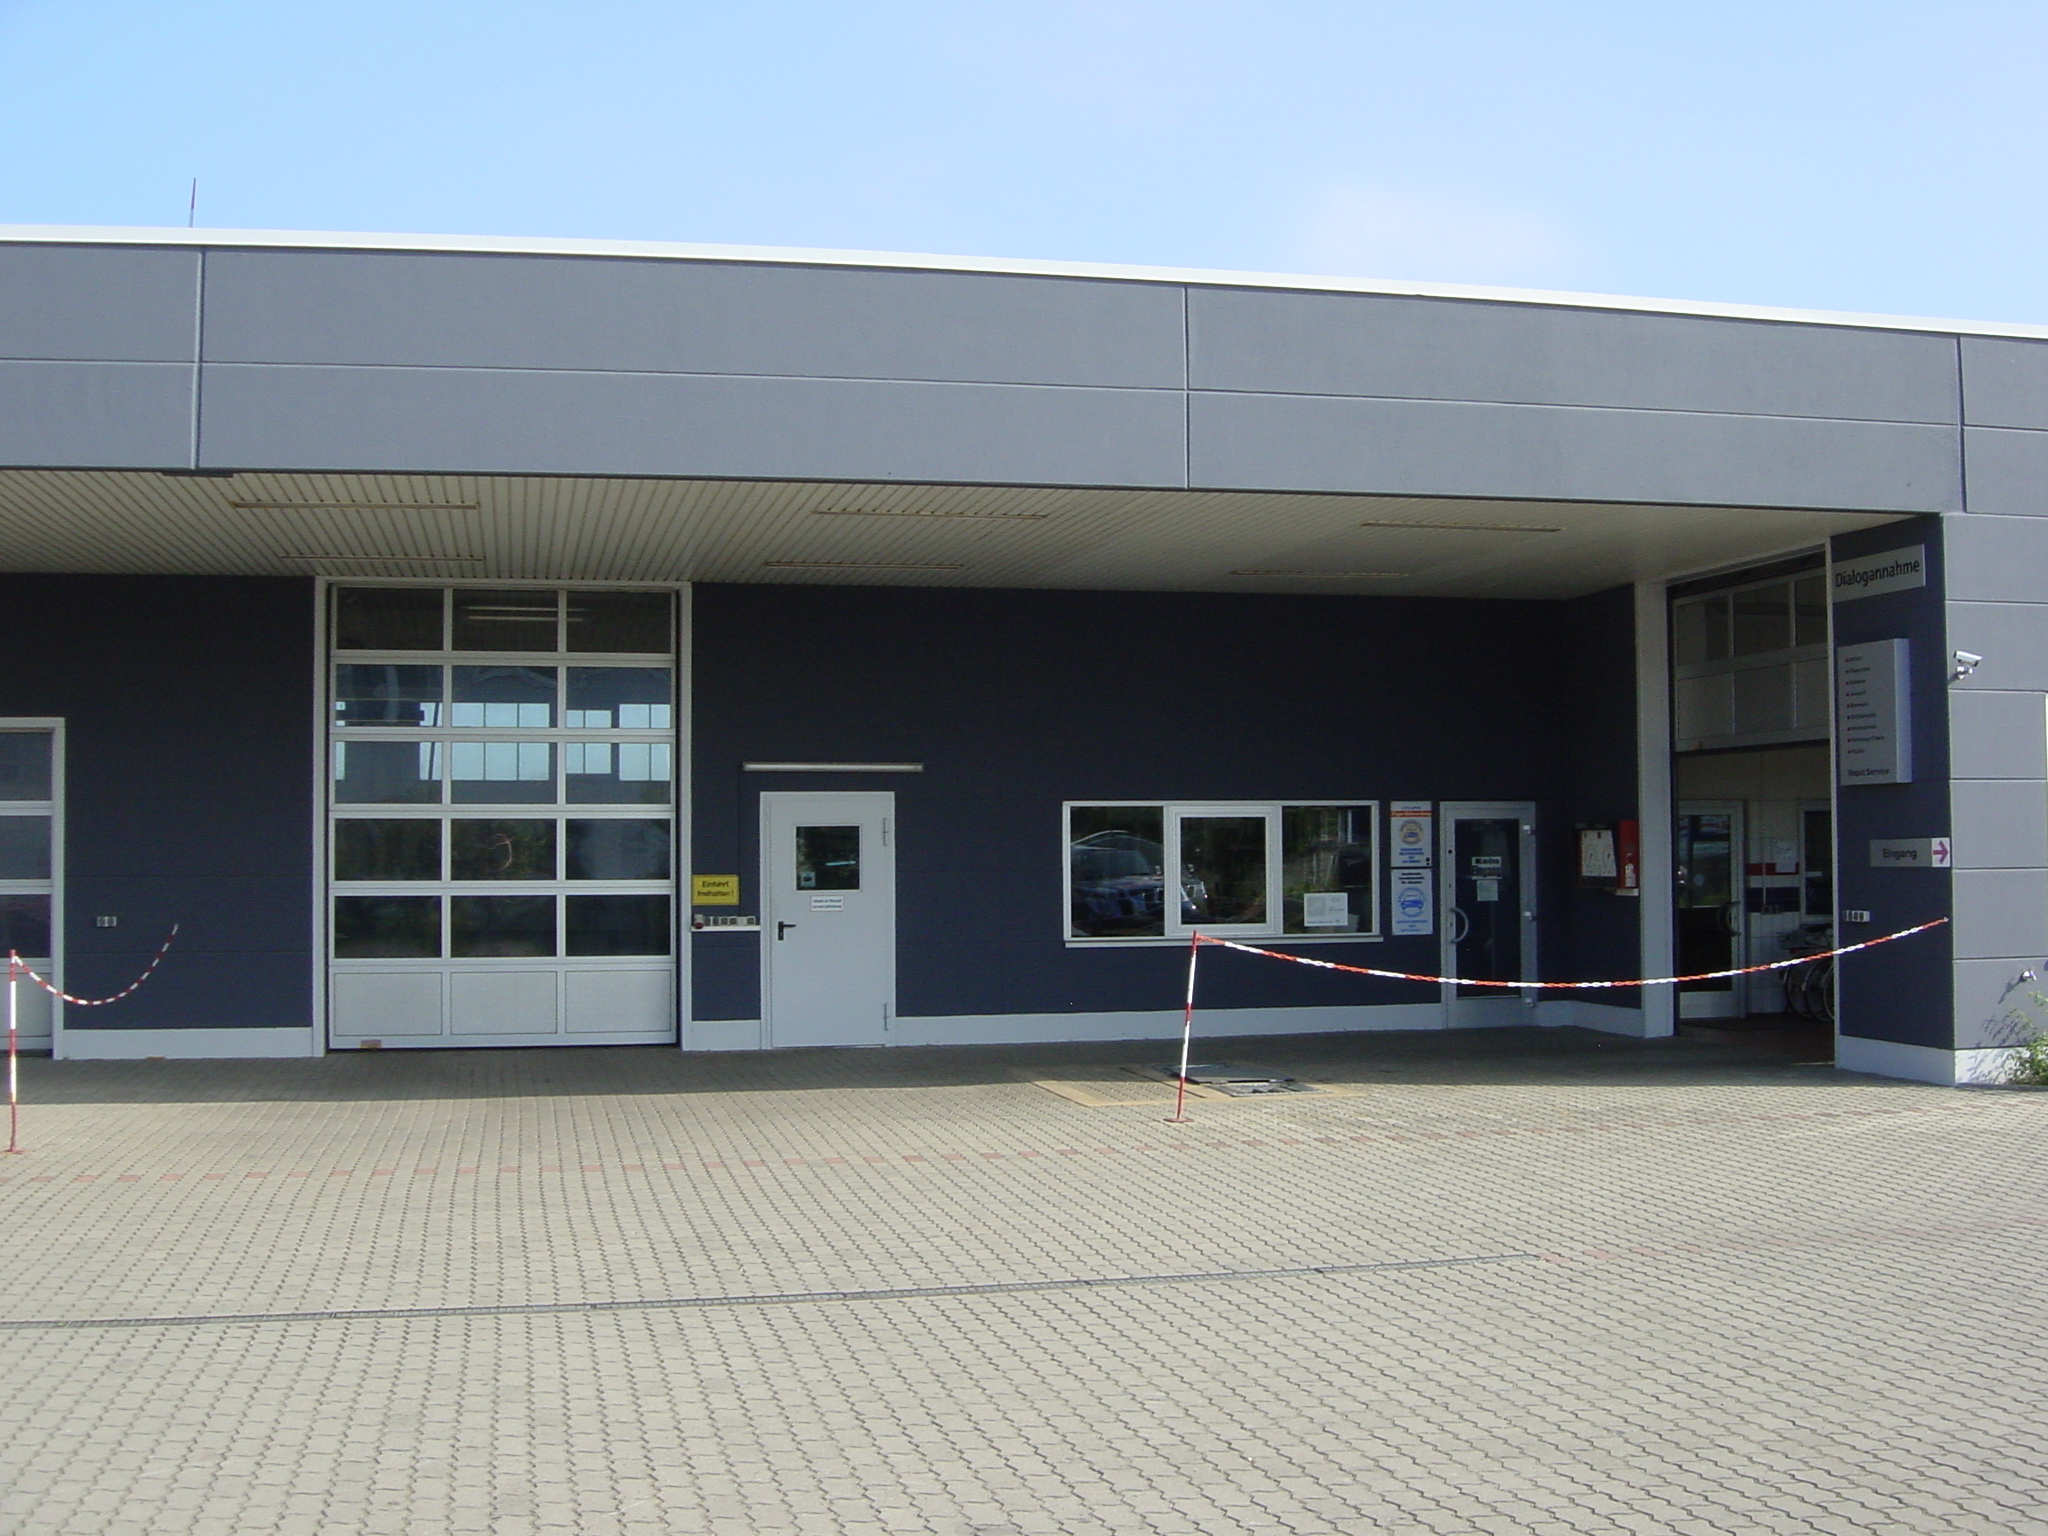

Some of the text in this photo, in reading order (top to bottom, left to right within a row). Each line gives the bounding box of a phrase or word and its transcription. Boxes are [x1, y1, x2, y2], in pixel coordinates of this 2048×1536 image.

[1836, 560, 1920, 587] Dialogannahme
[1882, 848, 1917, 860] Eingang
[702, 880, 730, 888] Einfahrt
